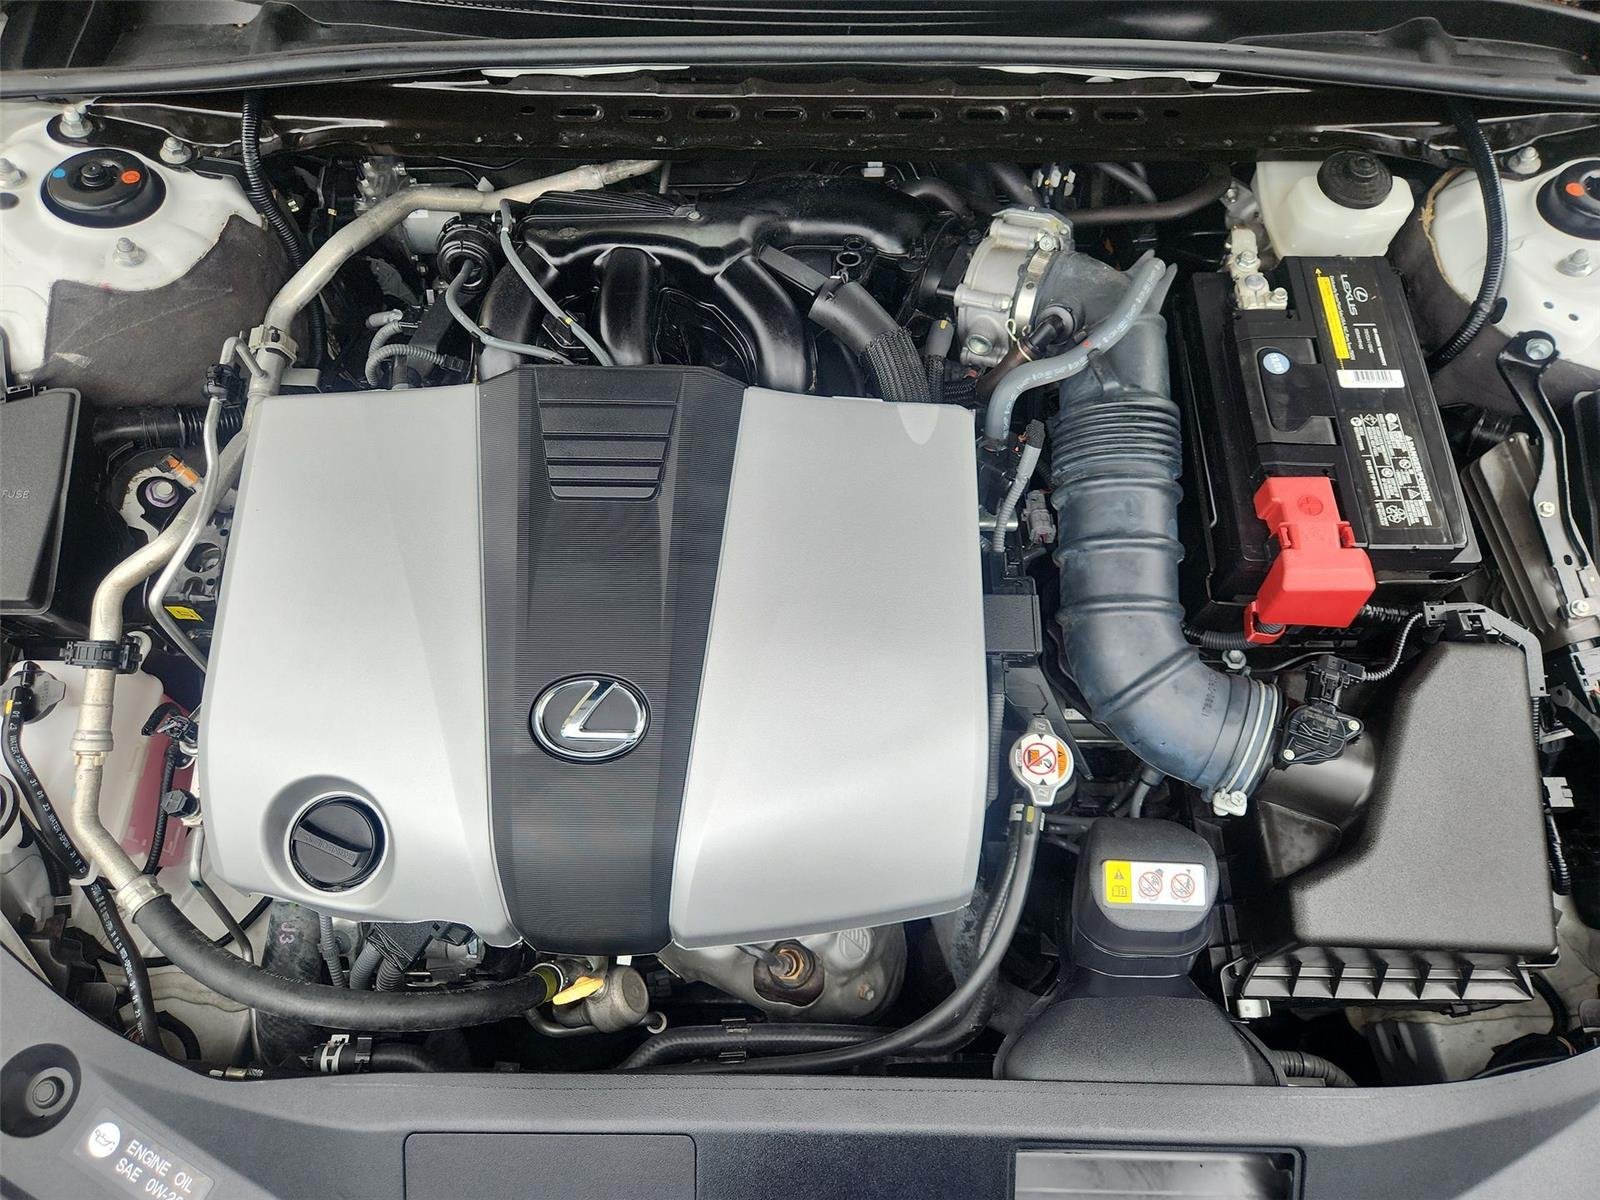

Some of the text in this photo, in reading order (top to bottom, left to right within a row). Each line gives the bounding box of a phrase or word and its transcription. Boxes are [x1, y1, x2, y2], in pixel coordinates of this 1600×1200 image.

[1340, 274, 1358, 316] LEXUS
[2, 489, 30, 499] FUSE
[9, 734, 19, 755] WATER
[29, 778, 38, 787] 31
[42, 802, 50, 811] 23
[48, 813, 61, 833] WATER
[115, 1157, 184, 1200] SAE 0W-2
[126, 1139, 193, 1194] ENGINE OIL
